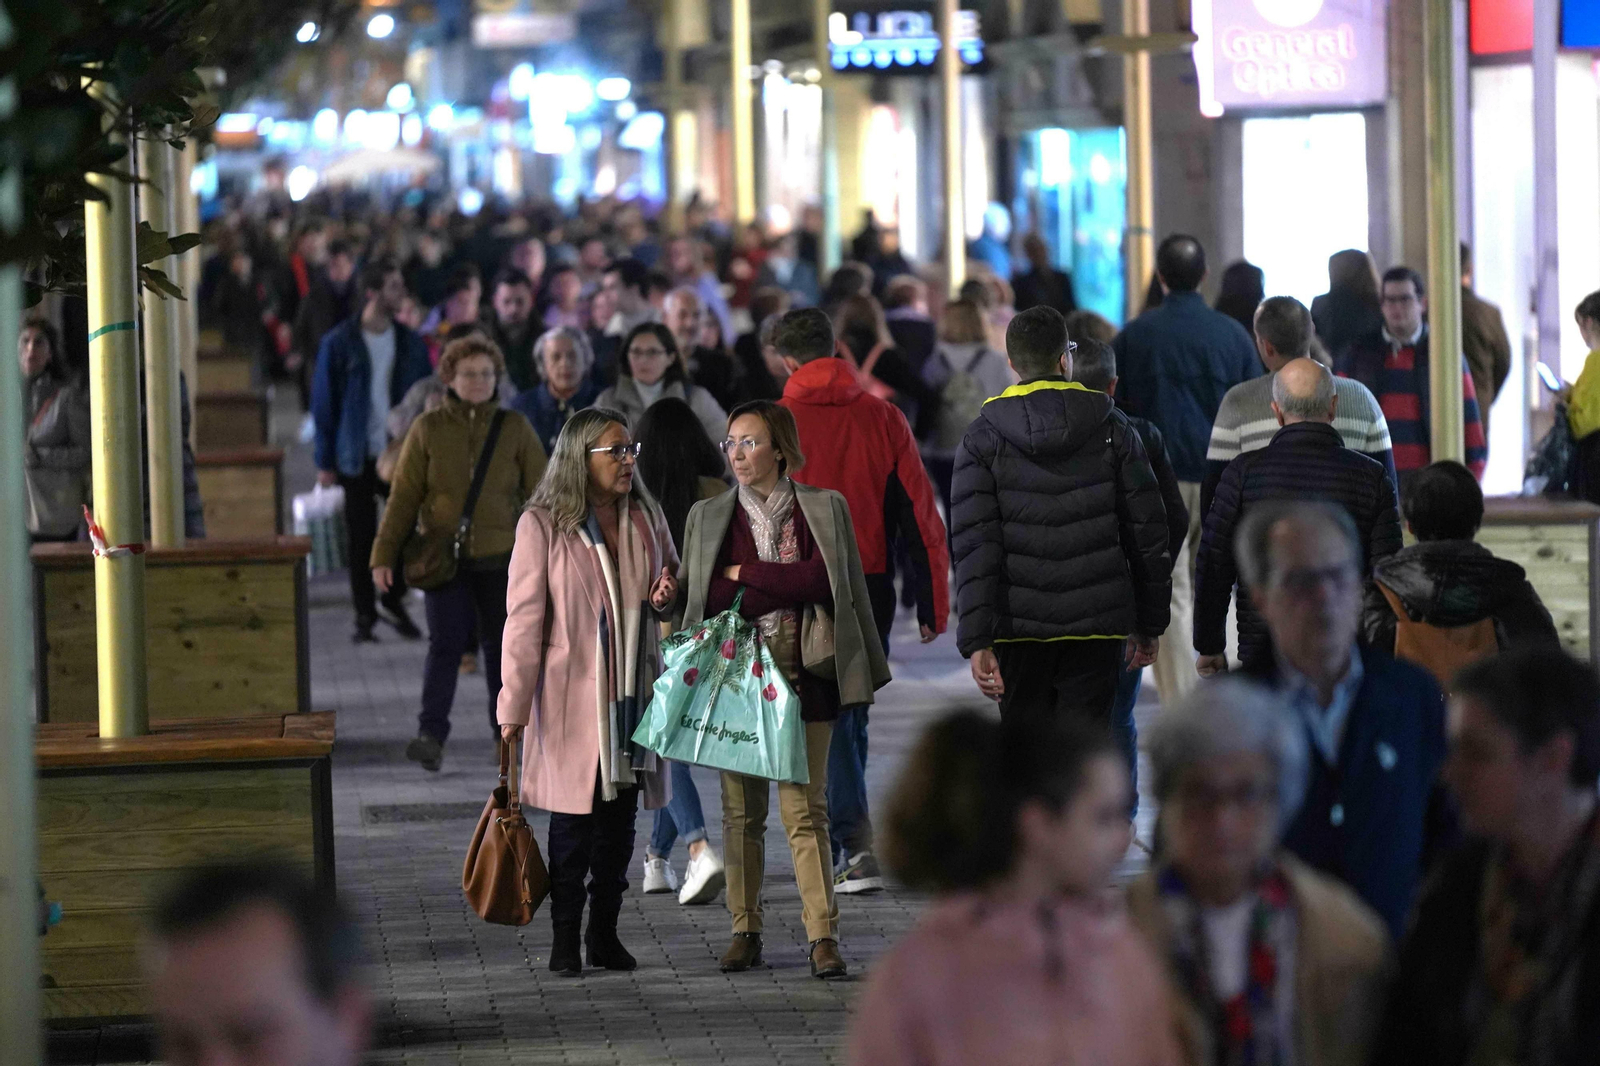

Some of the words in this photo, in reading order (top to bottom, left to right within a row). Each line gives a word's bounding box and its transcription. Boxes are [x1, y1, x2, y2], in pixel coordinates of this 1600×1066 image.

[1223, 24, 1354, 62] General
[681, 714, 692, 728] El
[718, 721, 759, 744] Inglés
